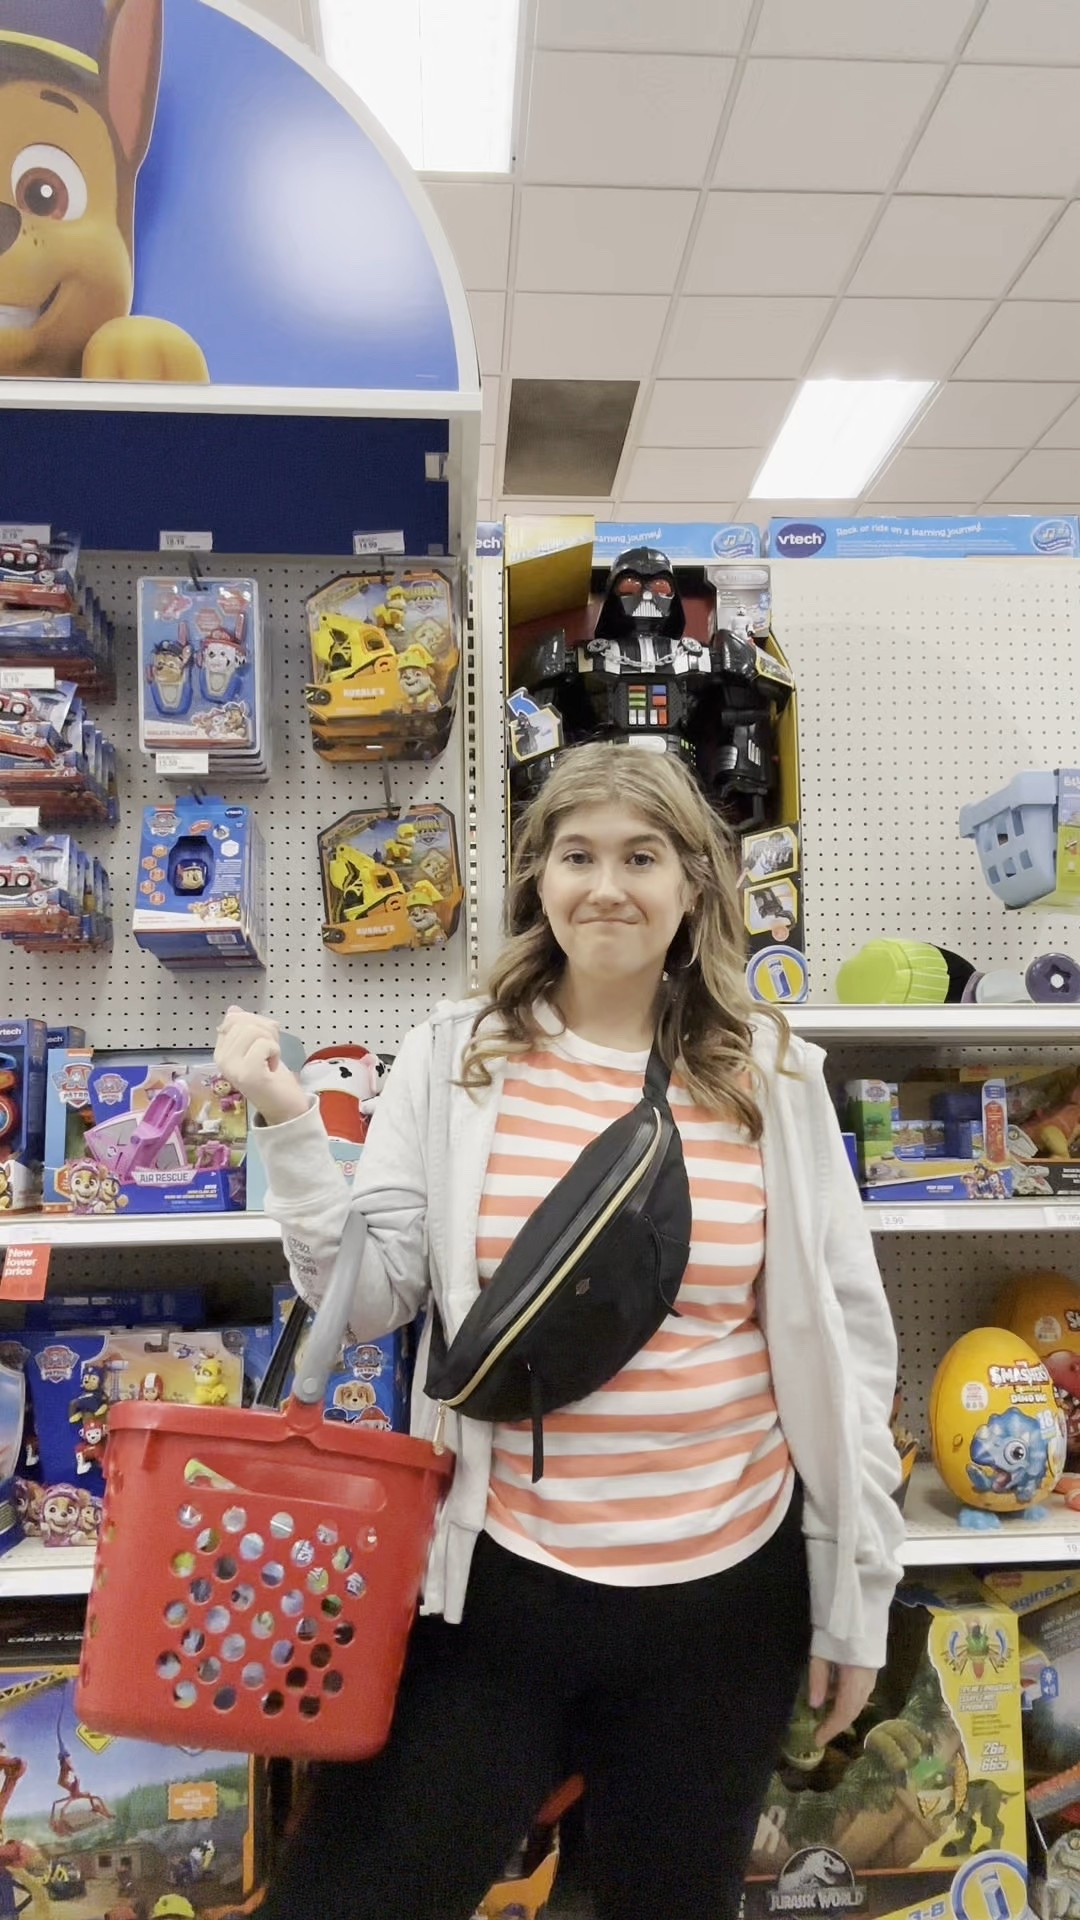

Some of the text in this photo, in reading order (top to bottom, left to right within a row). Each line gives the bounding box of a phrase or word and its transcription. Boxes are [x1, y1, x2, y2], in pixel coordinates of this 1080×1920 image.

[871, 524, 889, 532] ride
[911, 527, 946, 538] learning
[945, 521, 982, 538] journey!
[475, 536, 501, 549] ech
[625, 530, 662, 546] journey!
[778, 531, 823, 545] vtech
[47, 1035, 63, 1044] ech
[140, 1172, 189, 1183] AIR RESCUE
[8, 1248, 34, 1258] New
[6, 1257, 38, 1267] lower
[4, 1267, 33, 1278] price
[769, 1891, 816, 1912] JURASSIC
[817, 1889, 865, 1910] WORLD
[908, 1901, 945, 1920] 3-8
